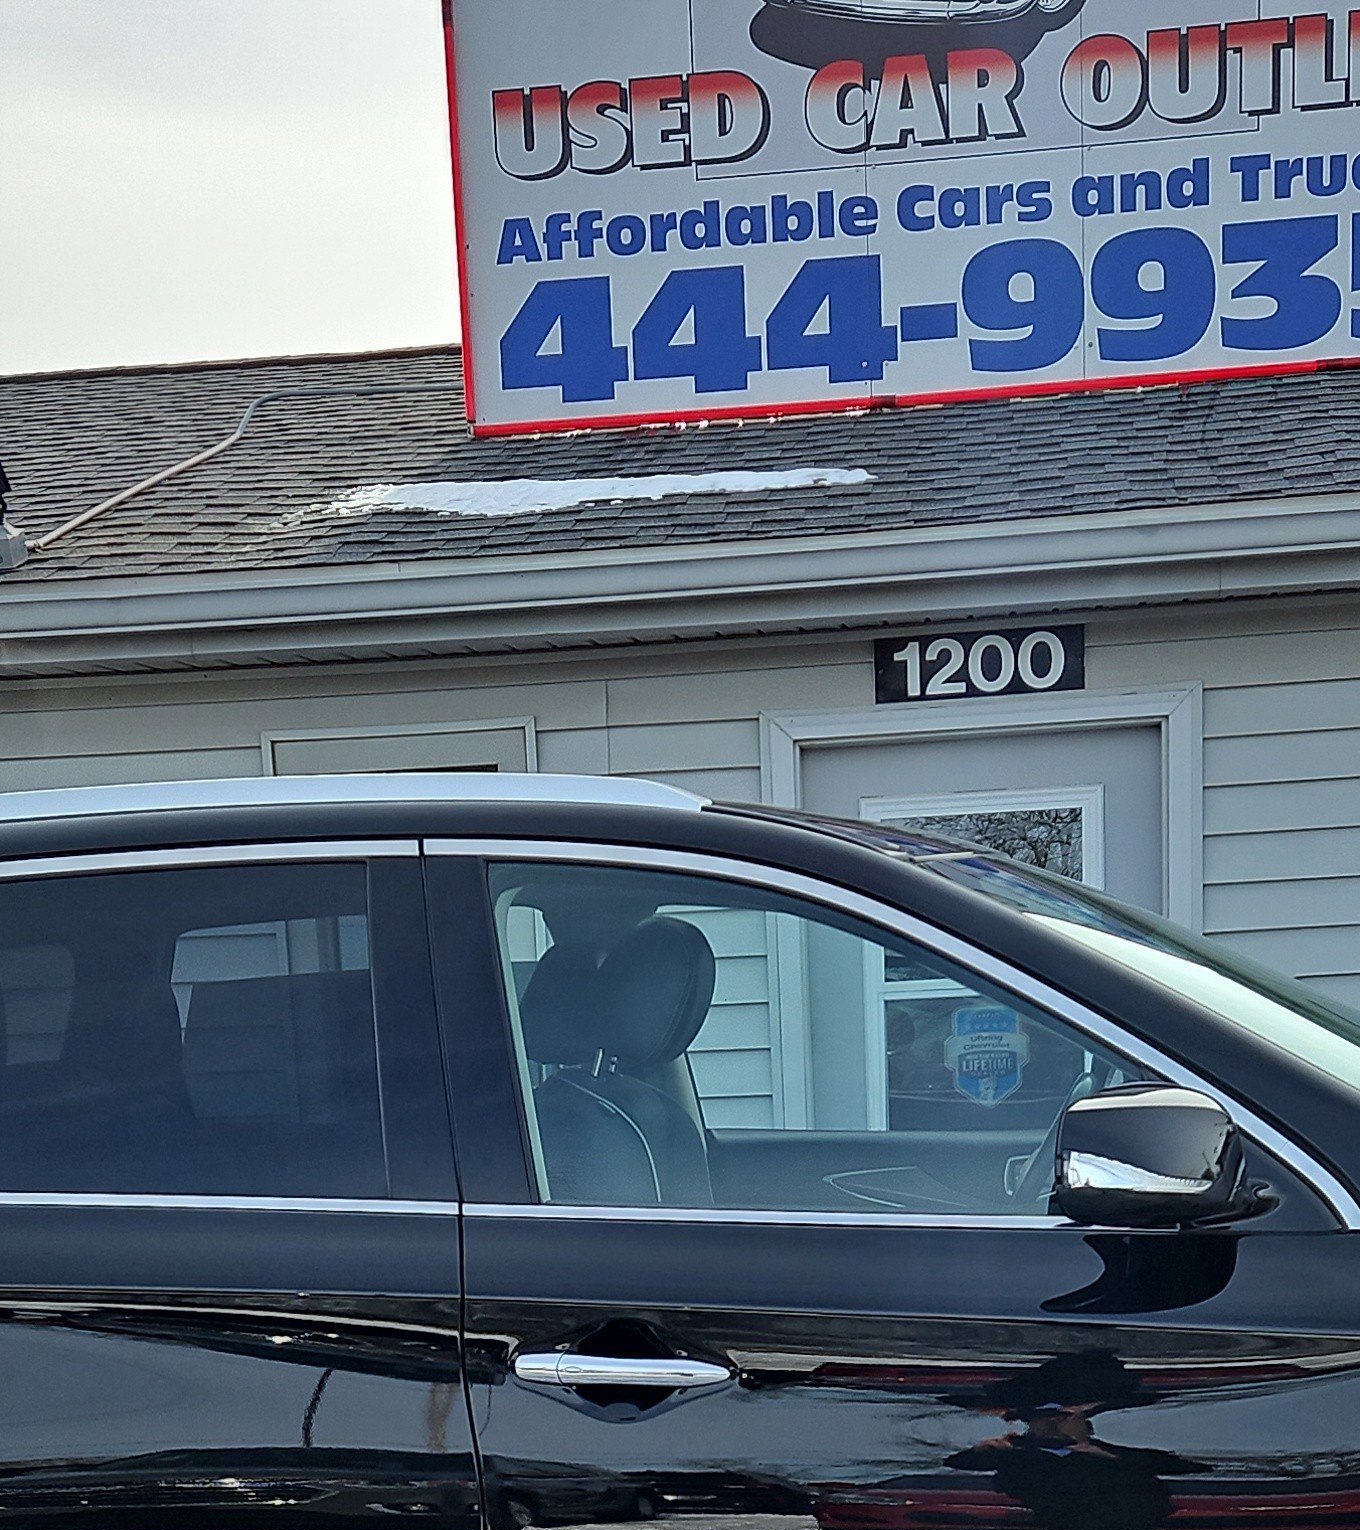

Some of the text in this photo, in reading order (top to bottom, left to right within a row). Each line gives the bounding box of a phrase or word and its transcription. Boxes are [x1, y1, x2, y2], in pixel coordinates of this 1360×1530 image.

[492, 70, 771, 181] USED
[805, 48, 1027, 154] CAR
[497, 189, 878, 265] Affordable
[897, 179, 1051, 232] Cars
[1072, 157, 1210, 216] and
[893, 631, 1065, 697] 1200
